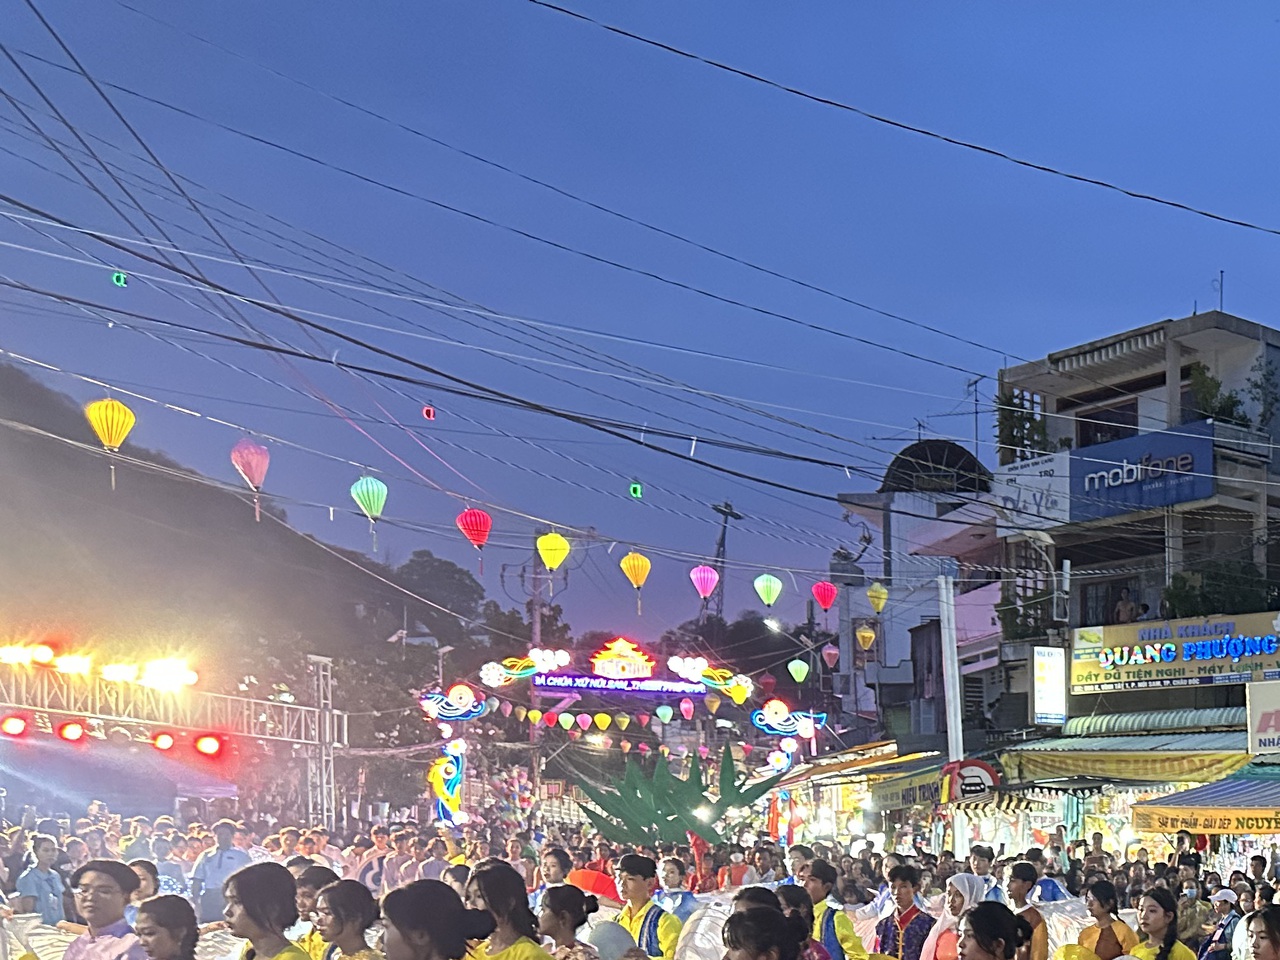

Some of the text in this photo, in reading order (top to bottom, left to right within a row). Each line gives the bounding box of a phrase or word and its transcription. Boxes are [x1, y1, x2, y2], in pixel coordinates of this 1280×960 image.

[1084, 453, 1194, 491] mobifone
[1138, 619, 1236, 641] NHÀ KHÁCH
[1098, 633, 1279, 670] QUANG PHƯỢNG
[1125, 667, 1152, 681] TIỆN
[1155, 667, 1186, 678] NGHI
[1197, 663, 1225, 675] MÁY
